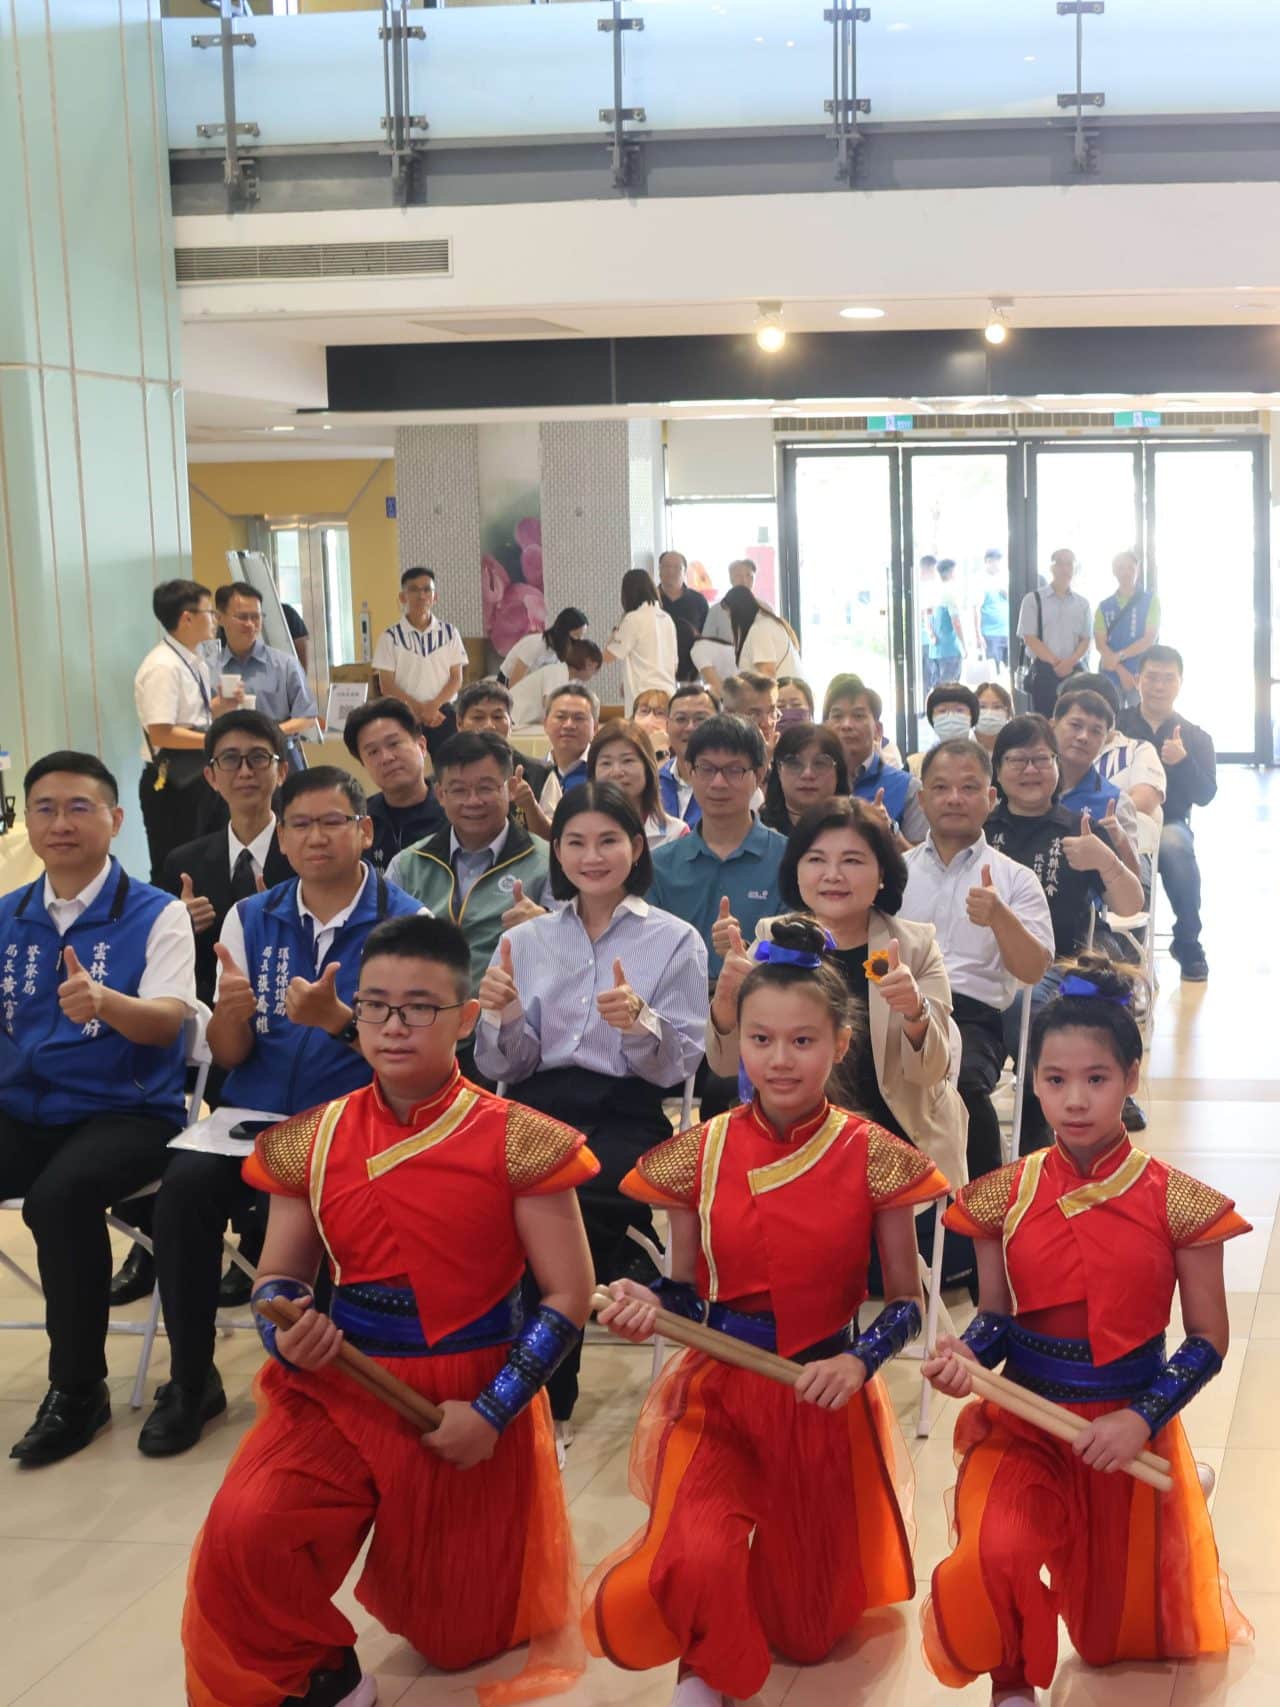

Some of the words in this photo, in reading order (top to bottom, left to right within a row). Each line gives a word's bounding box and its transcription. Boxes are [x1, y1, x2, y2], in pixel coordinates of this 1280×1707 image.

[23, 944, 40, 995] 警察局
[82, 942, 110, 1037] 雲林府
